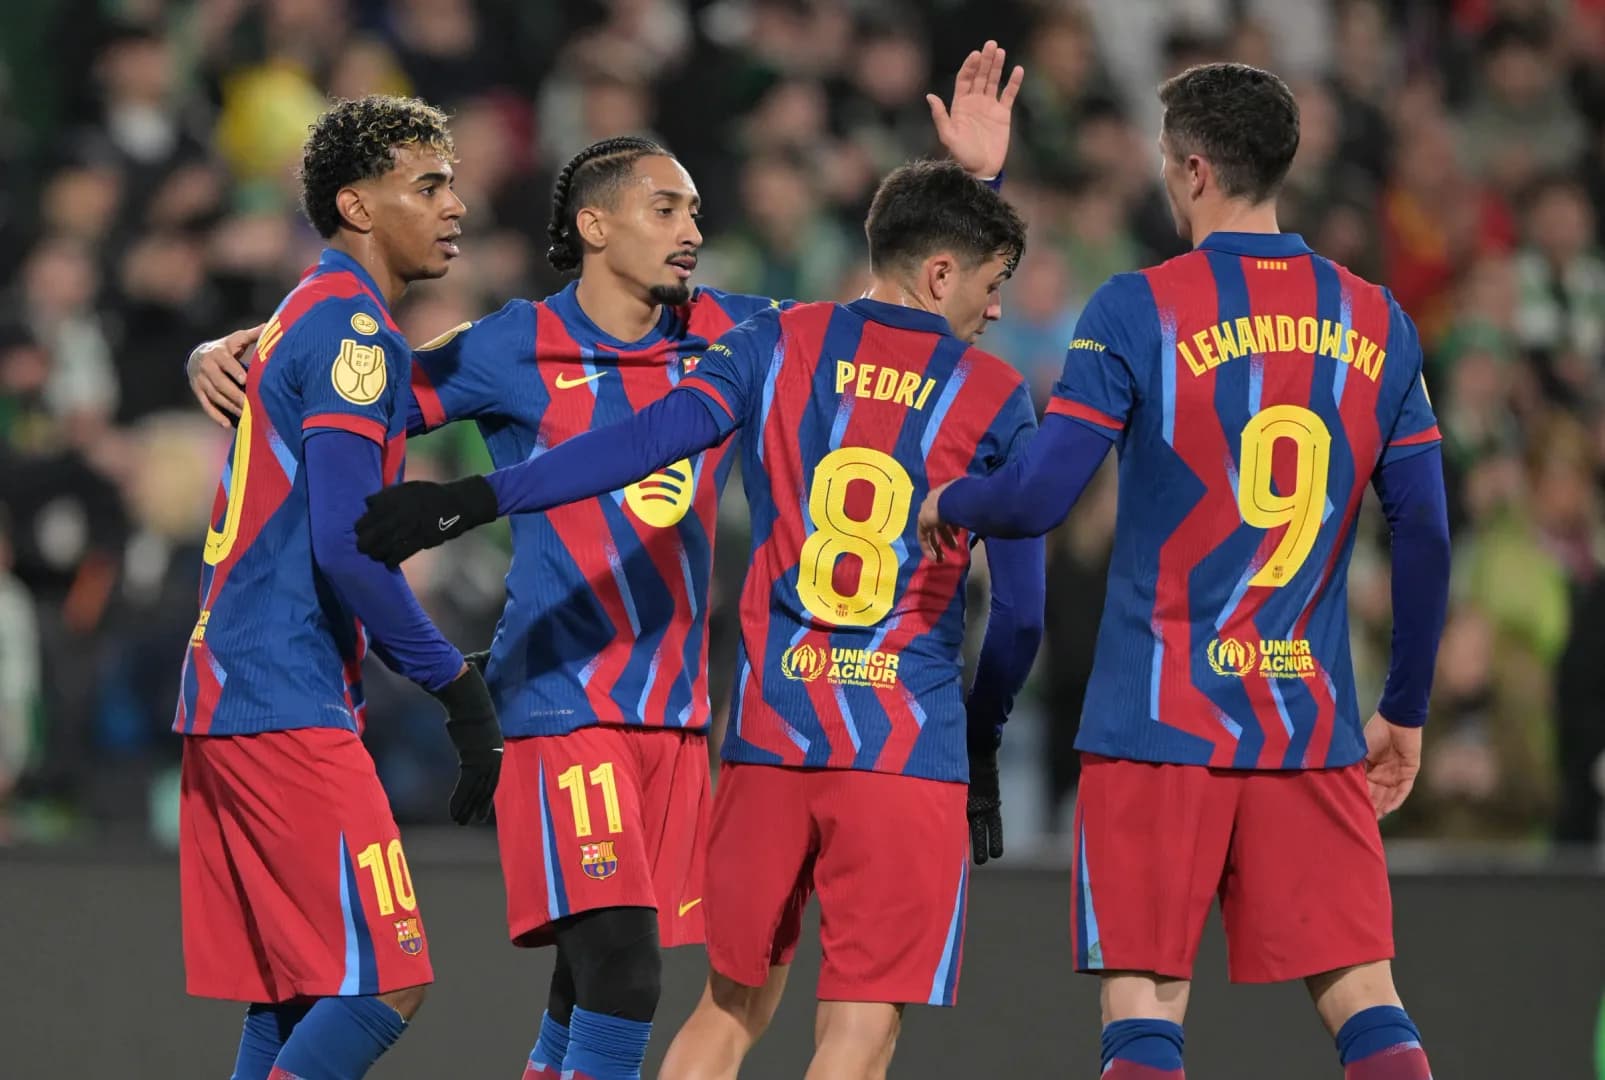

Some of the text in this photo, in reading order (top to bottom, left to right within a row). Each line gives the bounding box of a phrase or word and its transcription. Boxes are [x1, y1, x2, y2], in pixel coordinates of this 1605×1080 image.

[1177, 315, 1386, 383] LEWANDOWSKI
[835, 359, 937, 411] PEDRI
[1238, 404, 1332, 587] 9
[796, 446, 914, 626] 8
[827, 663, 897, 684] ACNUR
[831, 647, 899, 670] UNHCR
[1259, 655, 1314, 671] ACNUR
[1260, 639, 1311, 656] UNHCR
[558, 762, 623, 838] 11
[357, 838, 417, 916] 10
